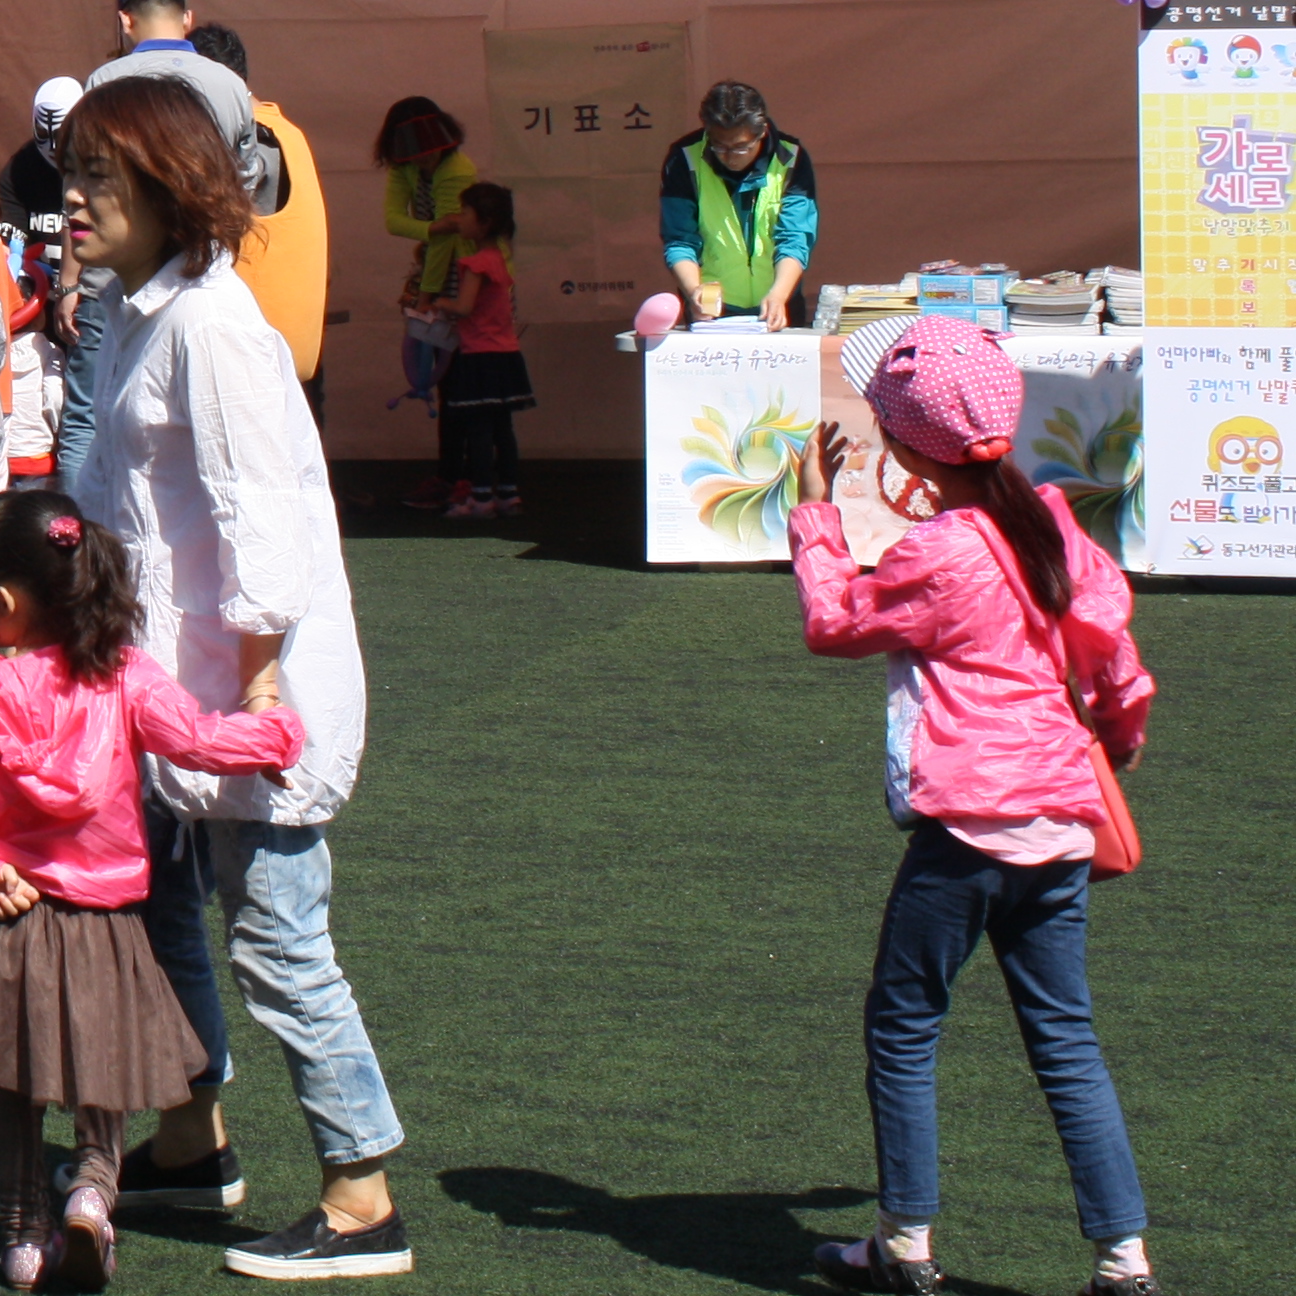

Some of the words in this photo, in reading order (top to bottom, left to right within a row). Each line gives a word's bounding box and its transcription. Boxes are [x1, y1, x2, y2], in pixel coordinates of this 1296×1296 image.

[1166, 6, 1241, 22] 공명선거
[1251, 5, 1296, 22] 낱말
[1202, 128, 1291, 175] 가로
[1205, 172, 1285, 208] 세로
[684, 347, 743, 373] 대한민국
[747, 348, 808, 371] 유권자다
[1037, 348, 1099, 374] 대한민국
[1157, 346, 1231, 369] 엄마아빠와
[1238, 346, 1271, 370] 함께
[1278, 346, 1296, 372] 풀
[1186, 379, 1250, 403] 공명선거
[1201, 474, 1257, 492] 퀴즈도
[1170, 498, 1237, 523] 선물도
